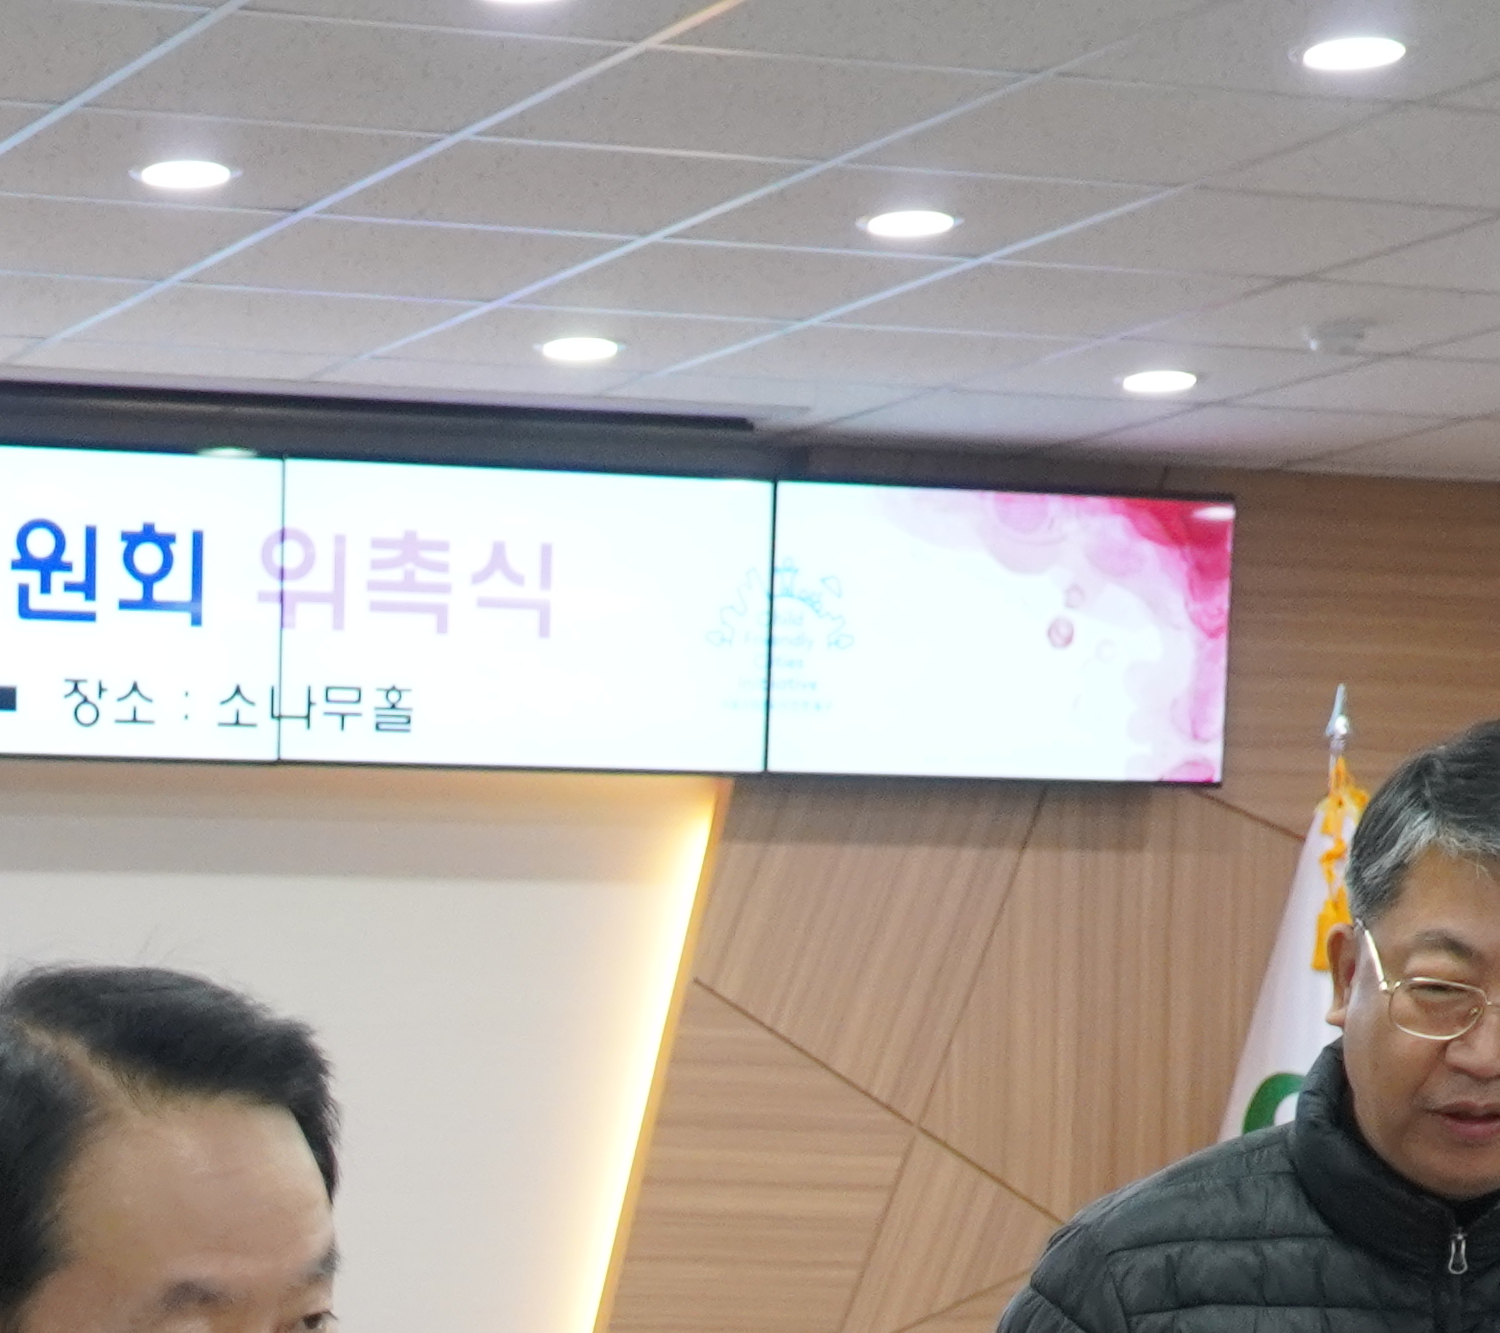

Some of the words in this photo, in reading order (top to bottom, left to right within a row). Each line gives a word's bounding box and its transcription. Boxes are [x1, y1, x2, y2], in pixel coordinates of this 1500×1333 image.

[254, 526, 556, 639] 위촉식
[63, 676, 158, 728] 장소
[216, 681, 416, 735] 소나무홀
